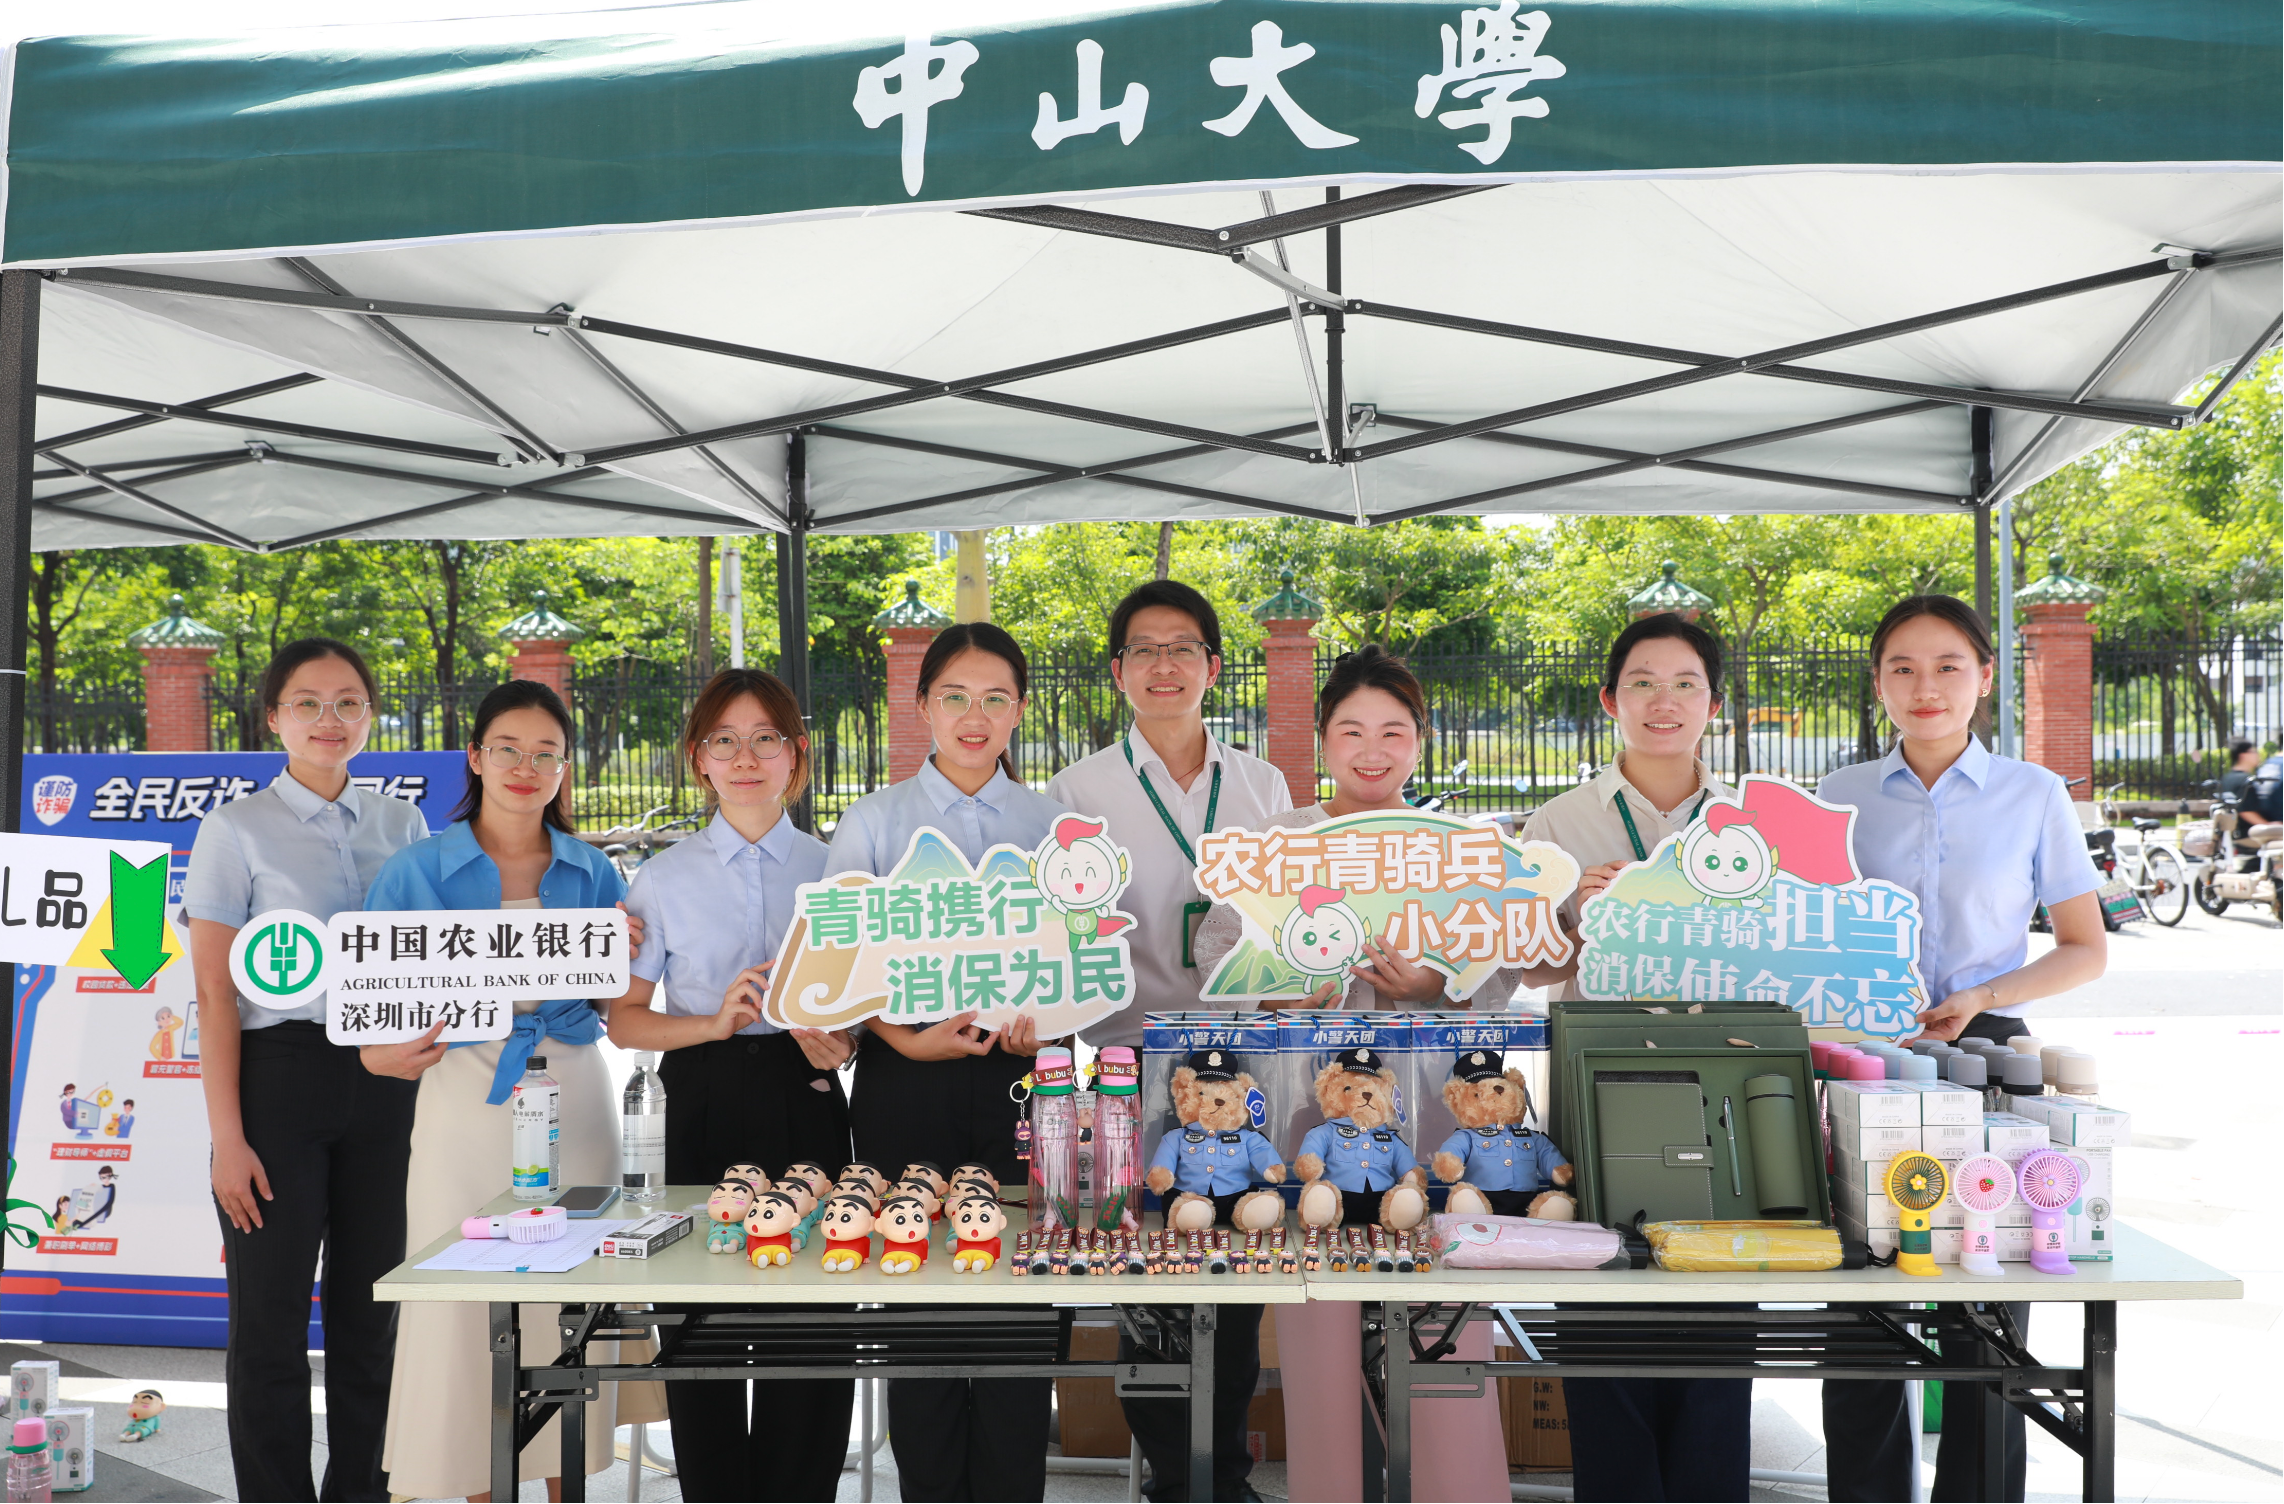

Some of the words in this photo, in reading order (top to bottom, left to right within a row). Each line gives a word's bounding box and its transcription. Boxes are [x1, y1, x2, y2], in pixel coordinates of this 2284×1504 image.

[38, 777, 72, 796] 谨防
[35, 797, 70, 815] 诈骗
[1202, 831, 1503, 896] 农行青骑兵
[804, 878, 1044, 948] 青骑携行
[1386, 901, 1567, 960] 小分队
[340, 921, 618, 964] 中国农业银行
[340, 976, 476, 991] AGRICULTURAL
[482, 974, 532, 989] BANK
[537, 974, 559, 988] OF
[565, 972, 617, 988] CHINA
[886, 946, 1127, 1016] 消保为民
[1588, 950, 1917, 1034] 消保使命不忘
[340, 999, 500, 1034] 深圳市分行
[1178, 1030, 1243, 1046] 小警天团
[1312, 1029, 1376, 1045] 小警天团
[1445, 1029, 1508, 1045] 小警天团
[1036, 1070, 1067, 1082] Labubu
[1097, 1064, 1125, 1074] Labubu
[1532, 1418, 1560, 1430] MEAS:
